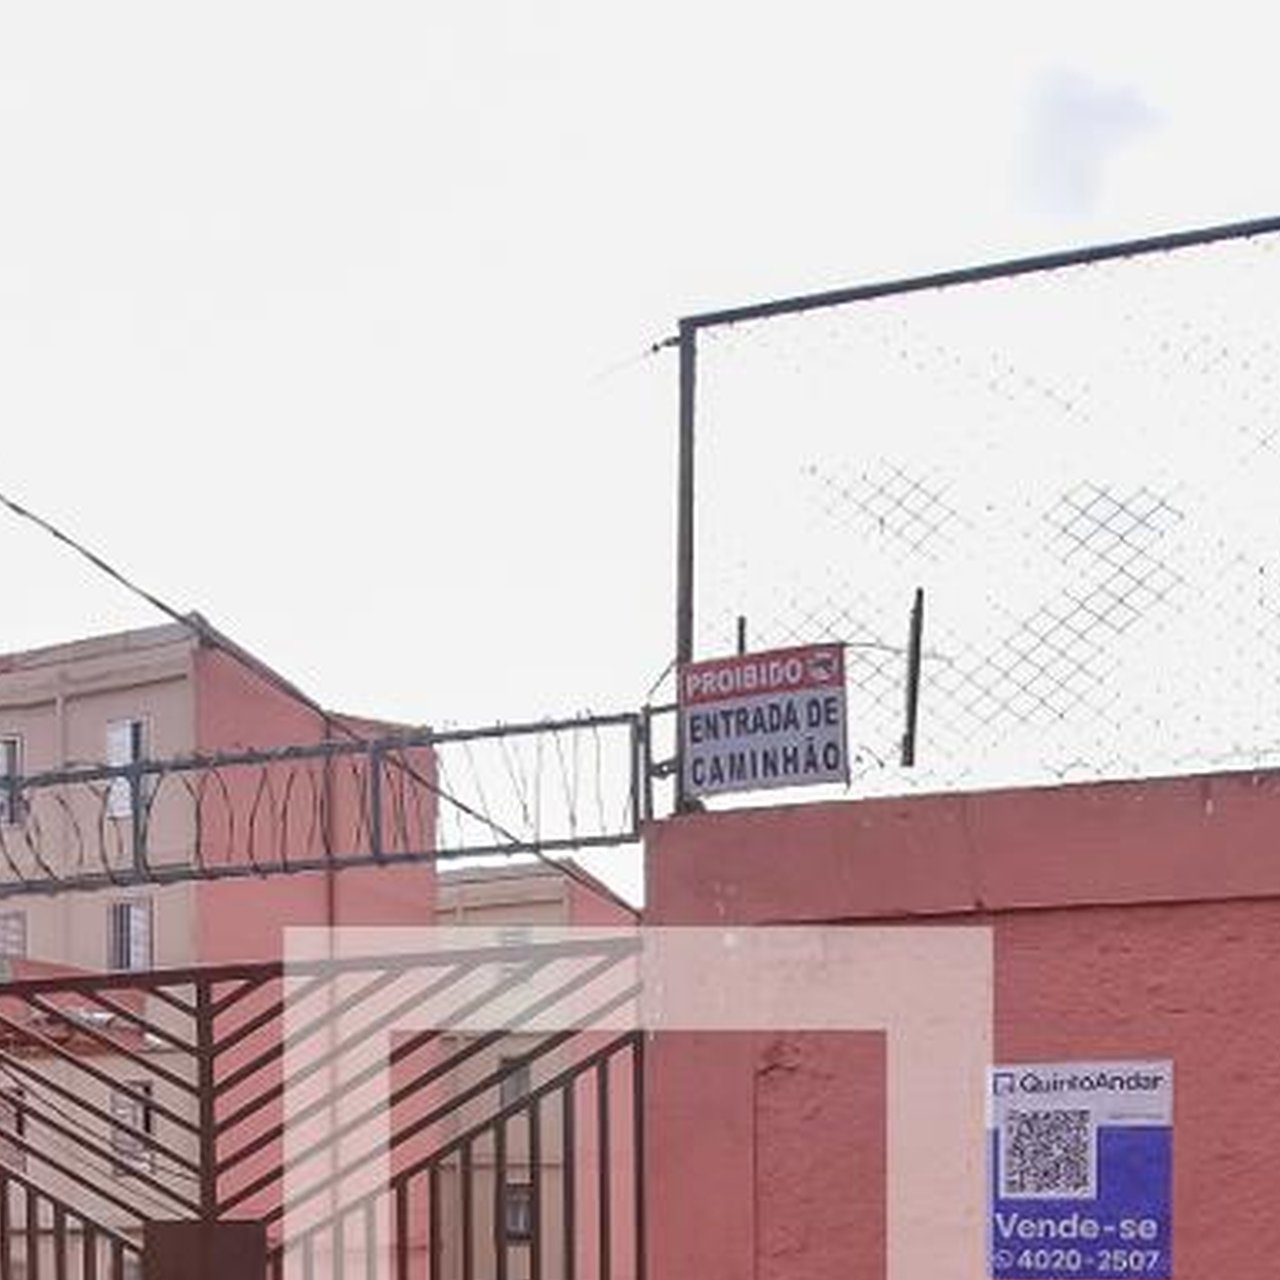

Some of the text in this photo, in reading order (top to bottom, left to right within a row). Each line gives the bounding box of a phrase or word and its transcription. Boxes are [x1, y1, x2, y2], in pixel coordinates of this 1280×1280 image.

[685, 657, 803, 698] PROIBIDO
[689, 697, 839, 743] ENTRADA DE
[691, 736, 840, 787] CAMINHÃO
[1020, 1073, 1165, 1094] QuintoAndar
[995, 1213, 1158, 1239] Vende-se
